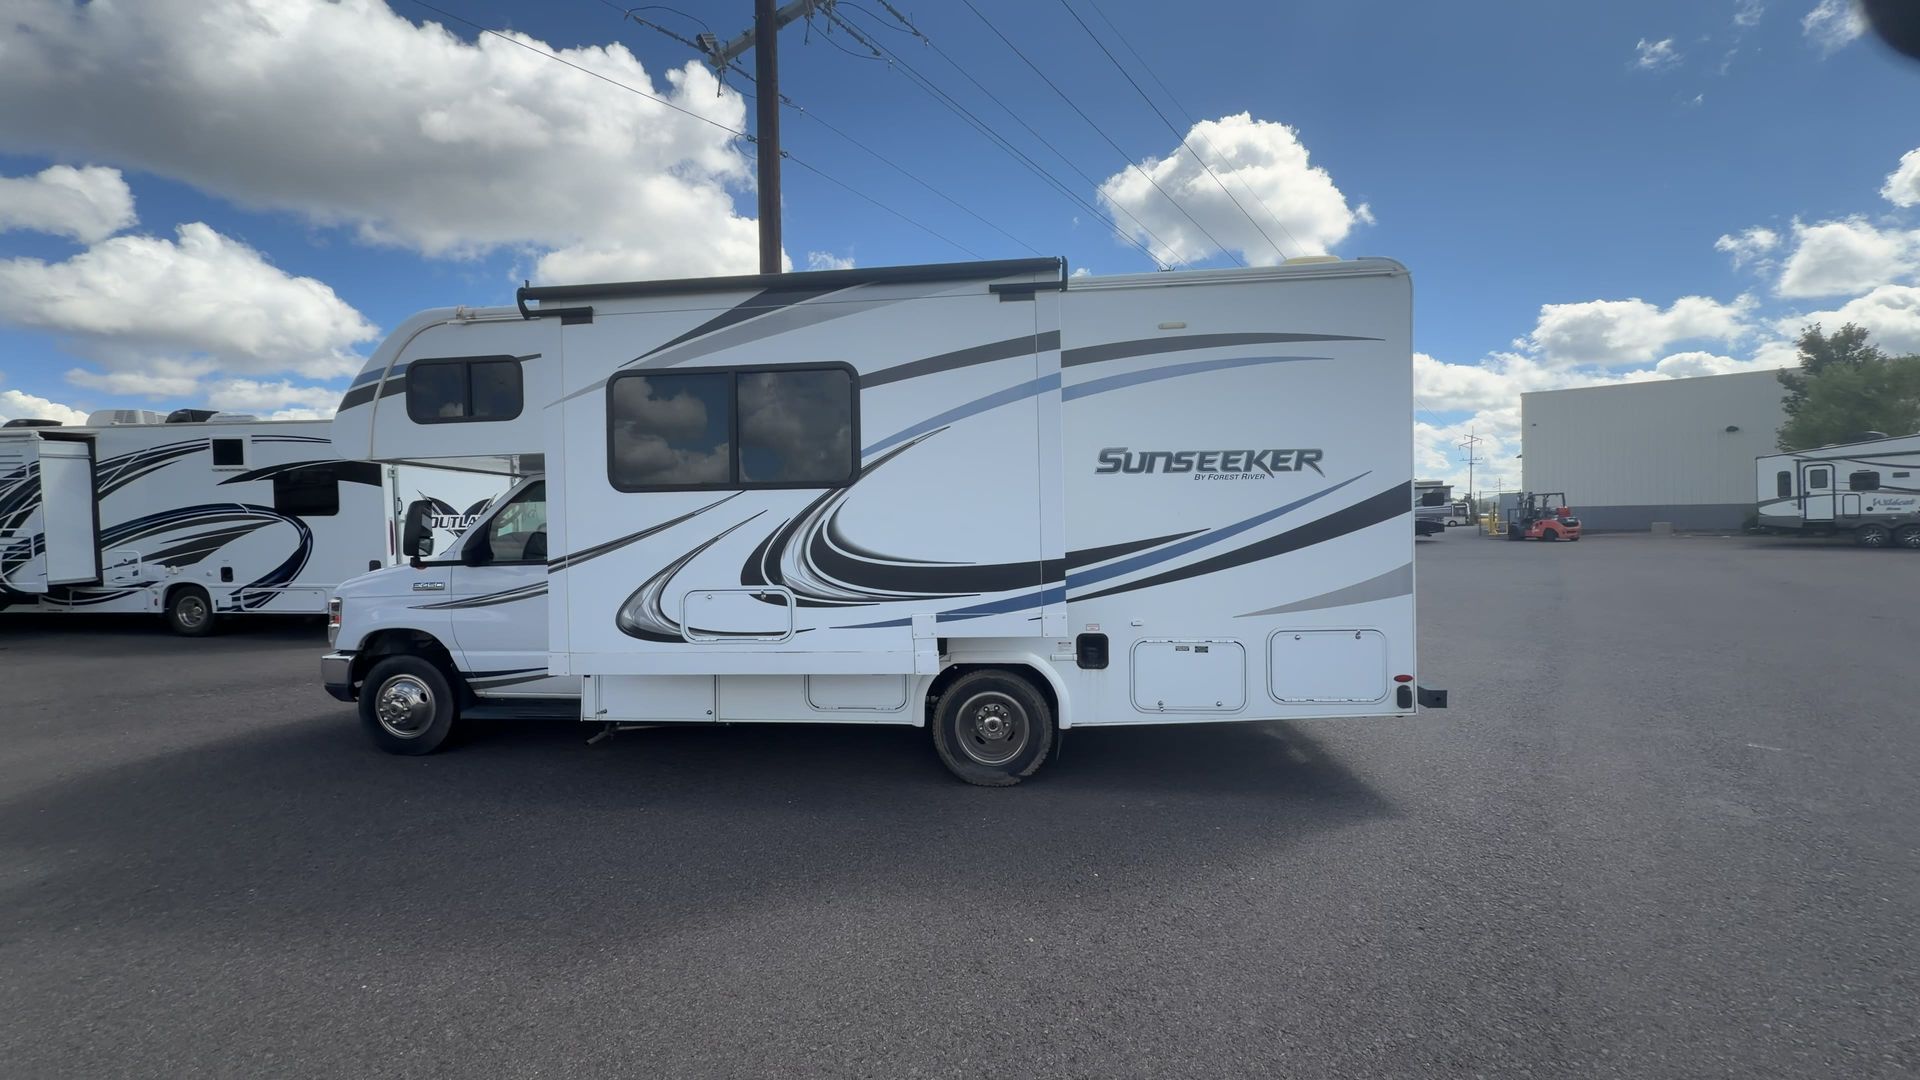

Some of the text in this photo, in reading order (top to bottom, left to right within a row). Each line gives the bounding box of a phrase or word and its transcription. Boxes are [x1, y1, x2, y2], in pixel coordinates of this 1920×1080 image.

[1095, 447, 1325, 478] SUNSEEKER
[1208, 473, 1240, 481] FOREST
[431, 516, 480, 528] OUTLA
